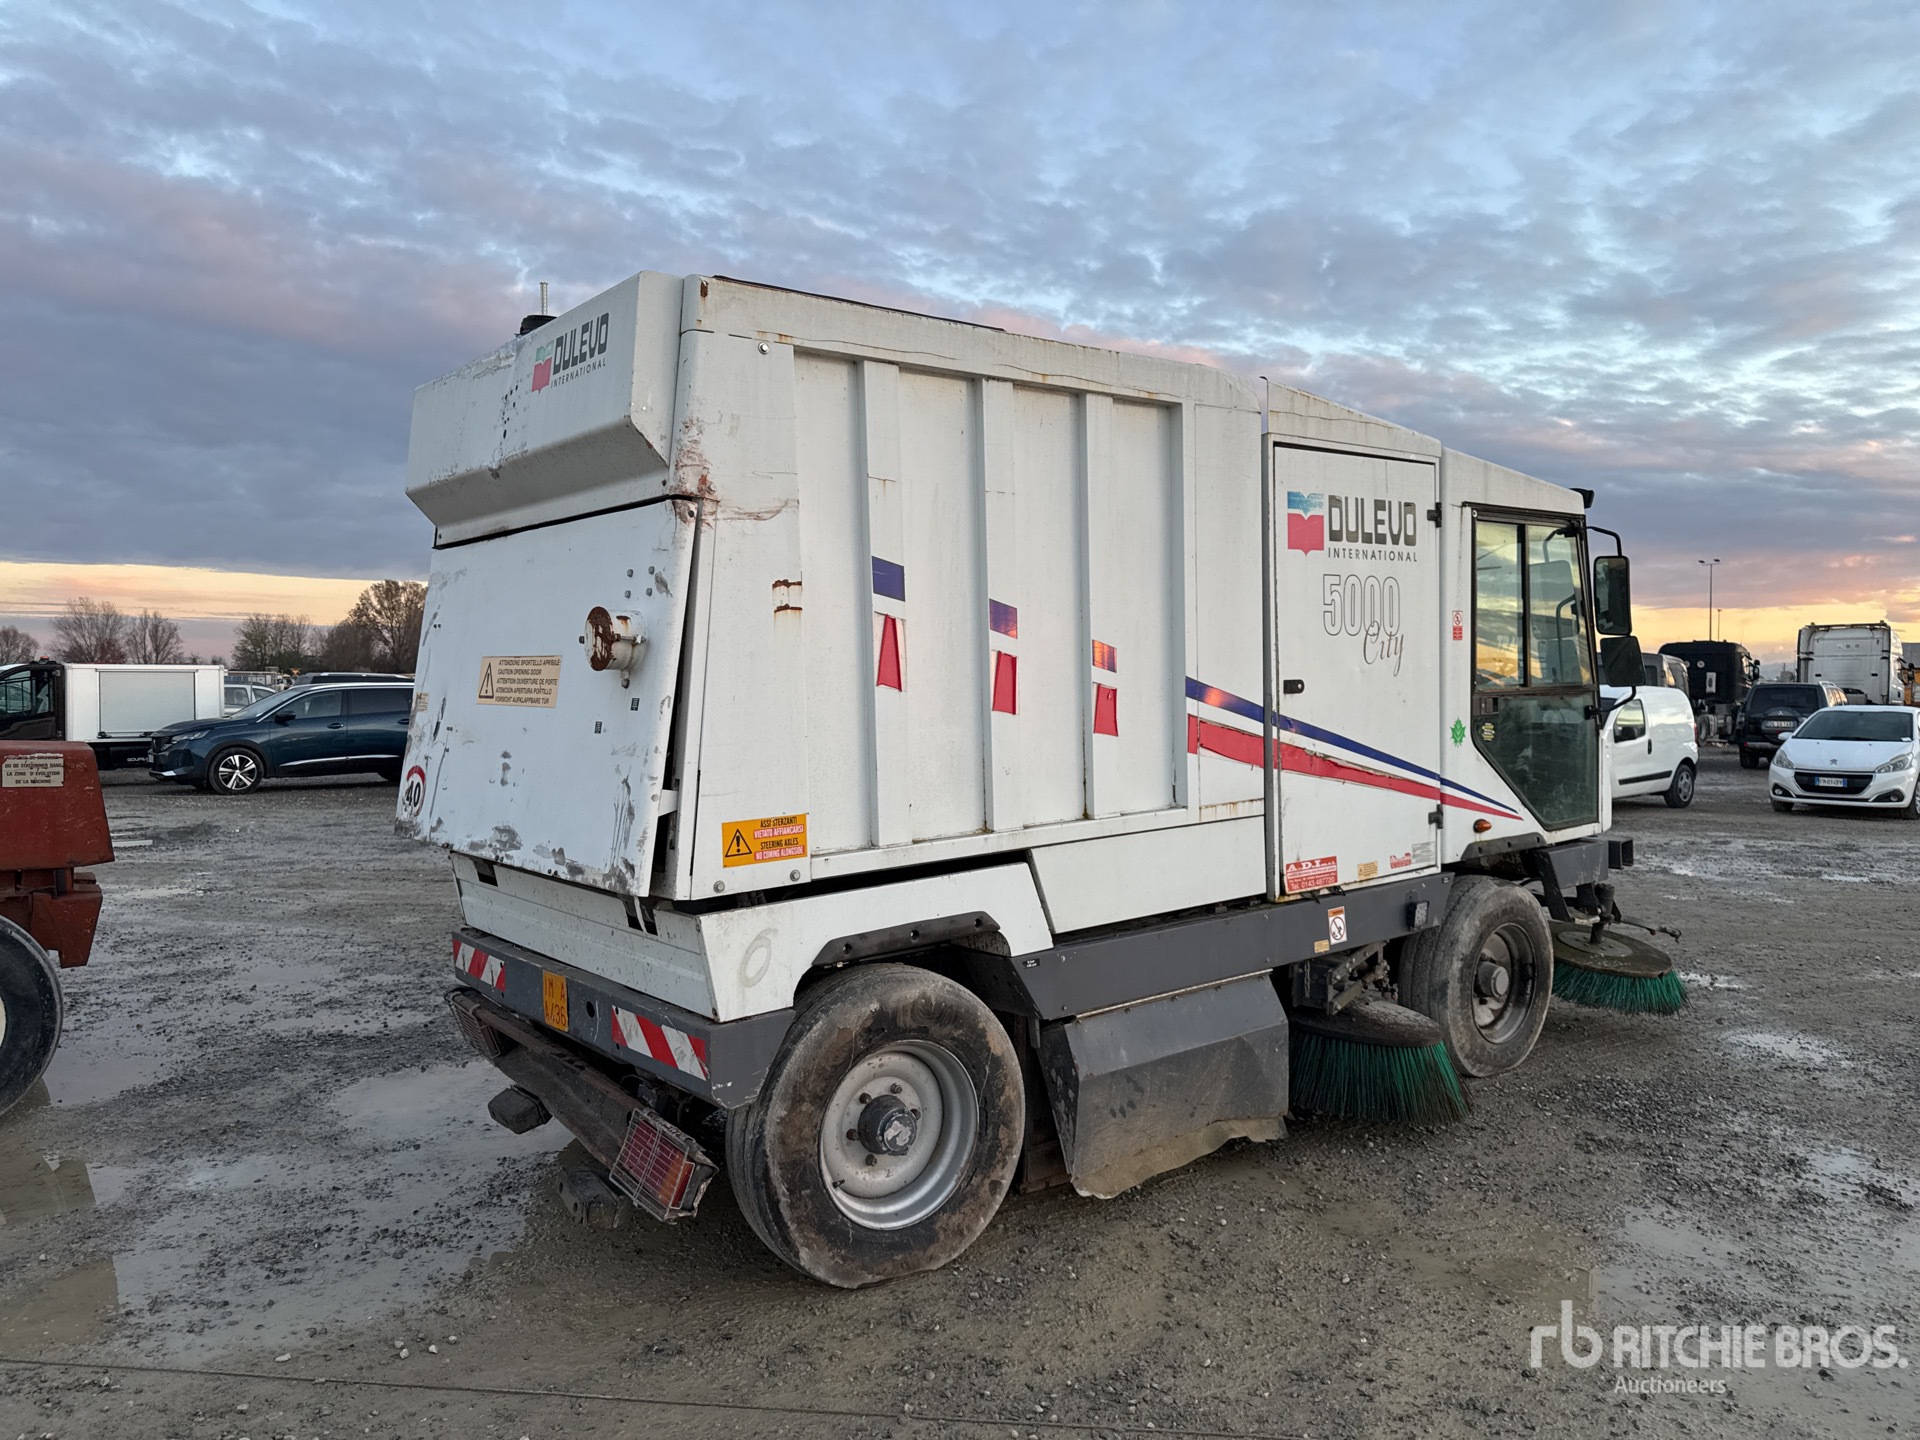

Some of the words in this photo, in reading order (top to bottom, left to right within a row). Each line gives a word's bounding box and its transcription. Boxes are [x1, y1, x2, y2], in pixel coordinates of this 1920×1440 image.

[553, 312, 609, 375] DULEVO
[550, 358, 606, 389] INTERNATIONAL
[1328, 494, 1417, 547] DULEVO
[1328, 547, 1418, 562] INTERNATIONAL
[1323, 573, 1401, 637] 5000
[1363, 620, 1404, 677] City
[404, 780, 421, 808] 40
[754, 829, 773, 839] VIETATO
[773, 825, 804, 836] AFFIANCARSI
[760, 819, 771, 828] ASSI
[772, 816, 798, 826] STERZANTI
[755, 852, 762, 860] NO
[763, 849, 780, 859] COMING
[780, 845, 804, 857] ALONGSIDE
[760, 839, 783, 850] STEERING
[784, 837, 799, 846] AXLES
[1290, 882, 1300, 890] Tel.
